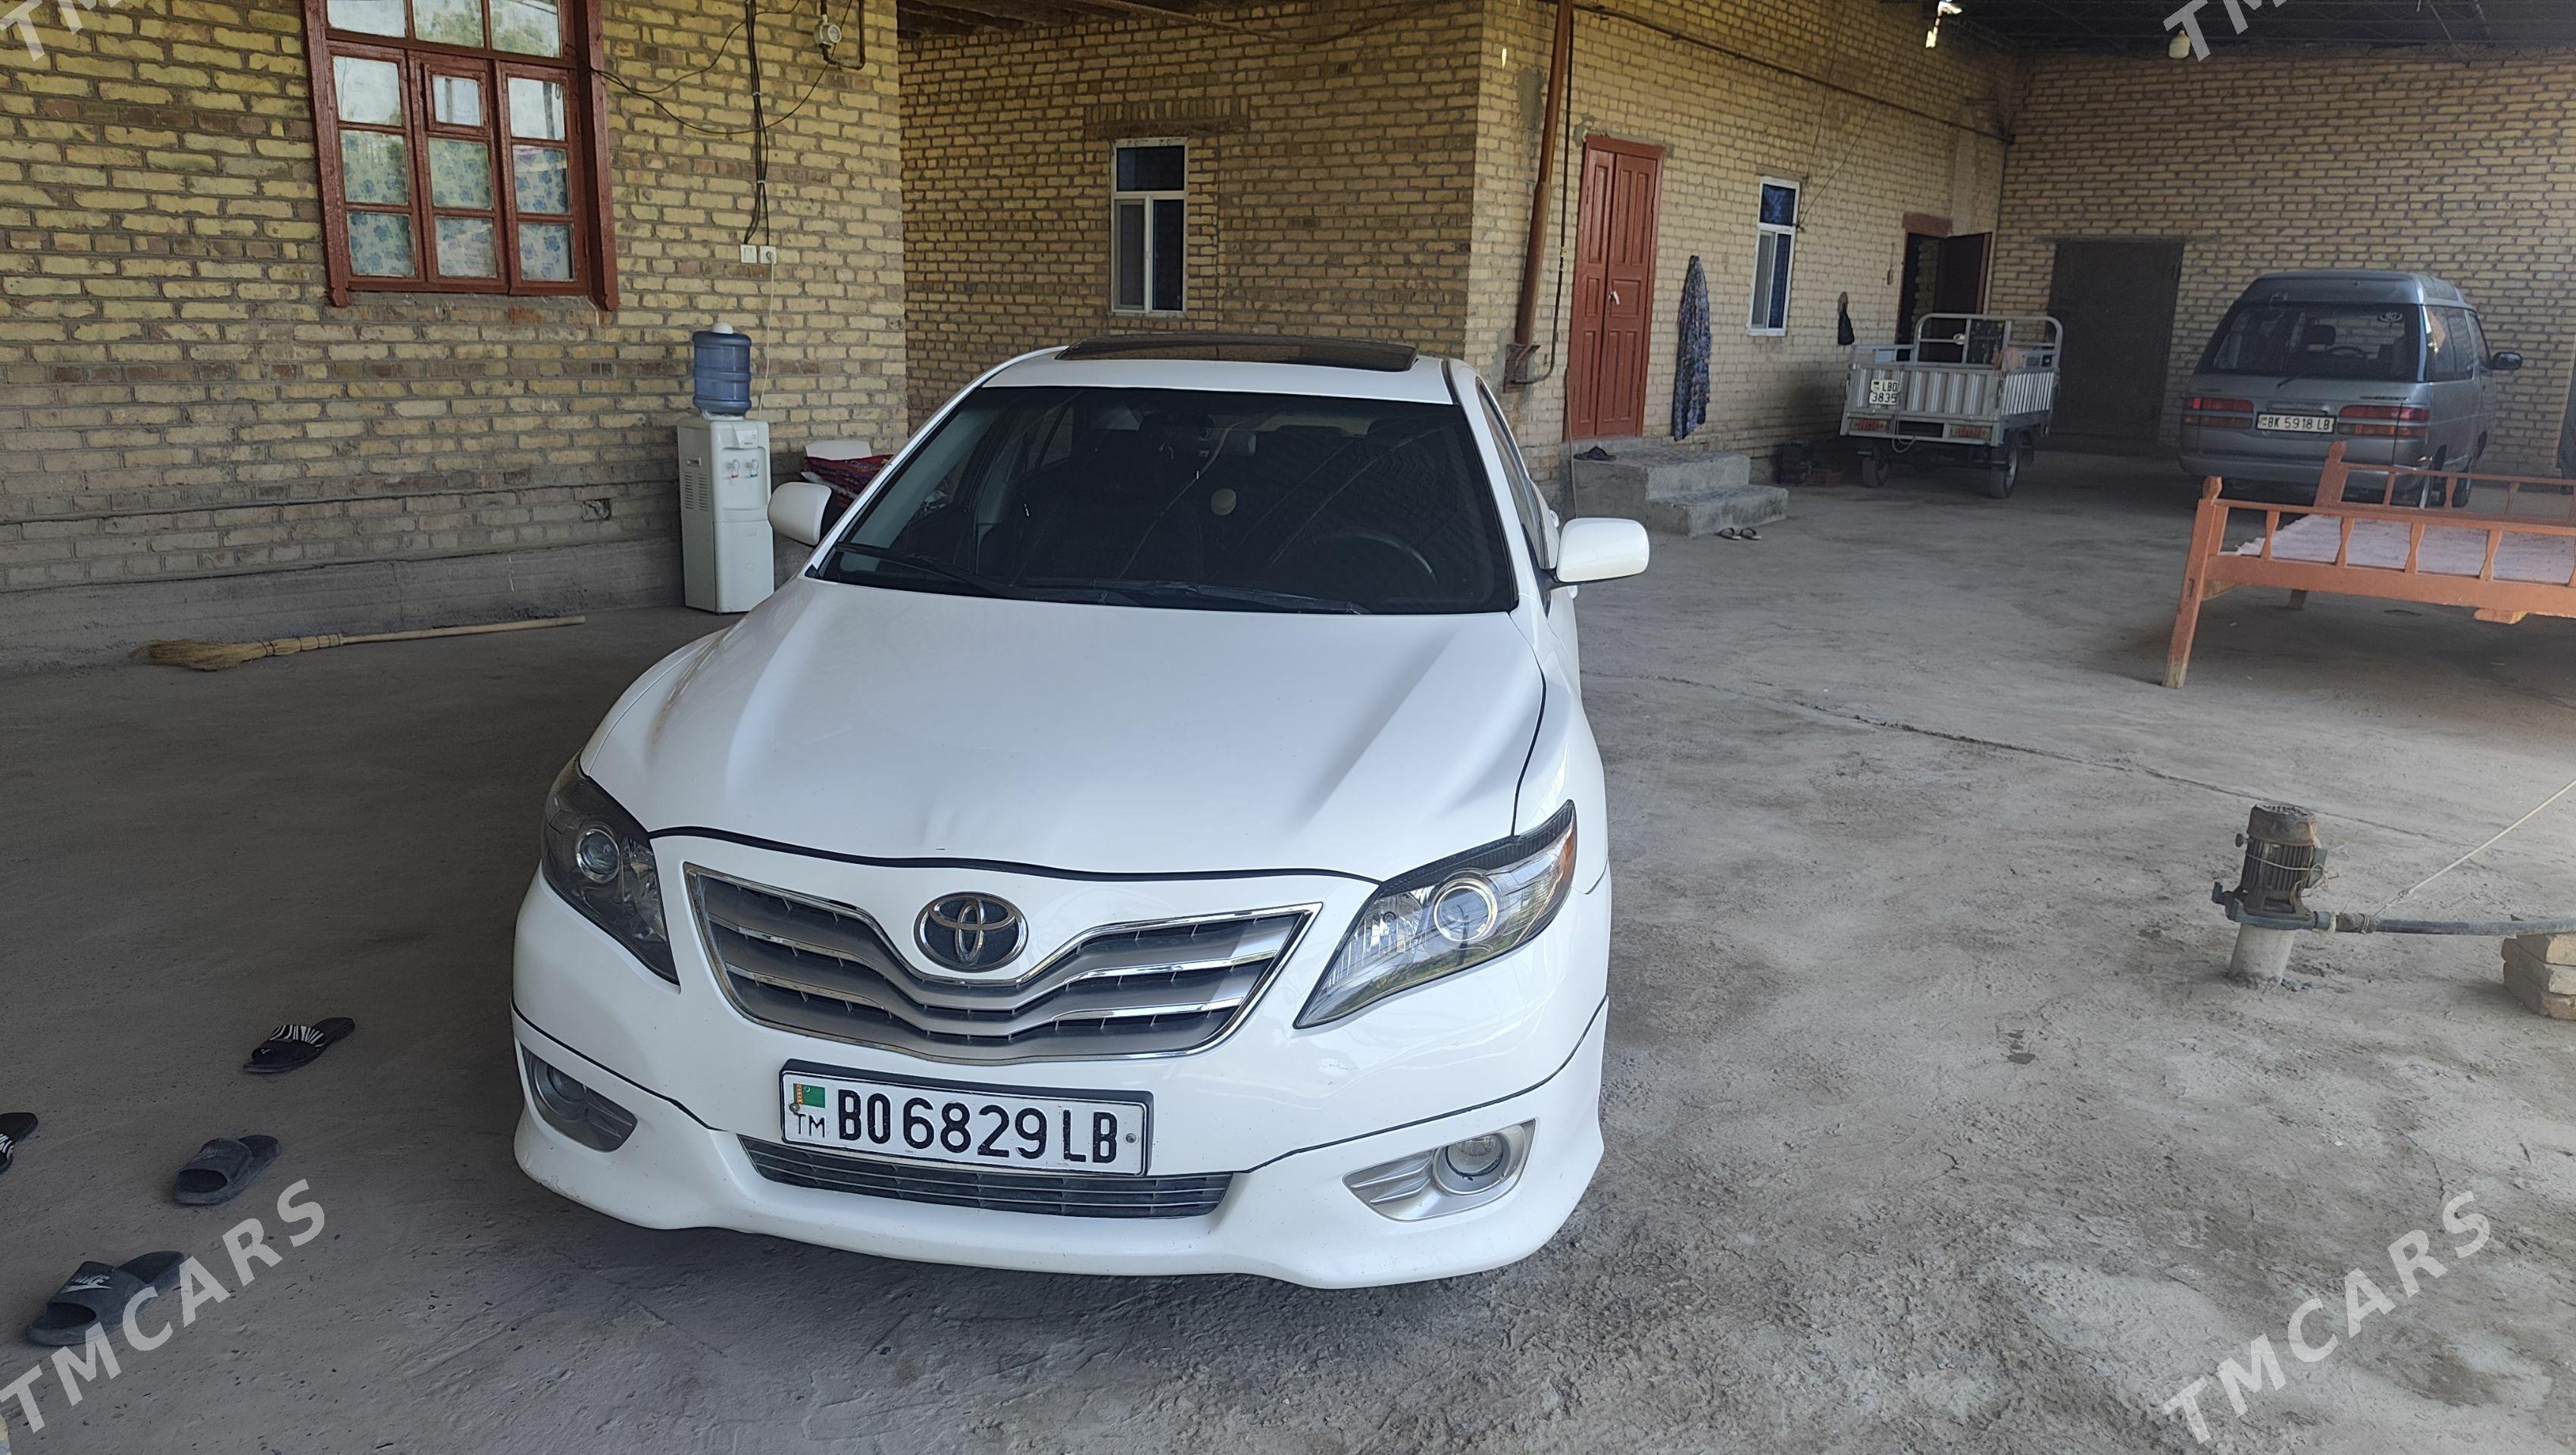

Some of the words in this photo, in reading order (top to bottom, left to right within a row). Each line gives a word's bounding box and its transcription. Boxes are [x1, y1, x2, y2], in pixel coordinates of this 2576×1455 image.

[1871, 392, 1897, 403] 3835
[2268, 416, 2280, 428] BK
[2284, 418, 2313, 430] 5918
[2317, 419, 2331, 430] LB
[796, 1112, 826, 1138] TM
